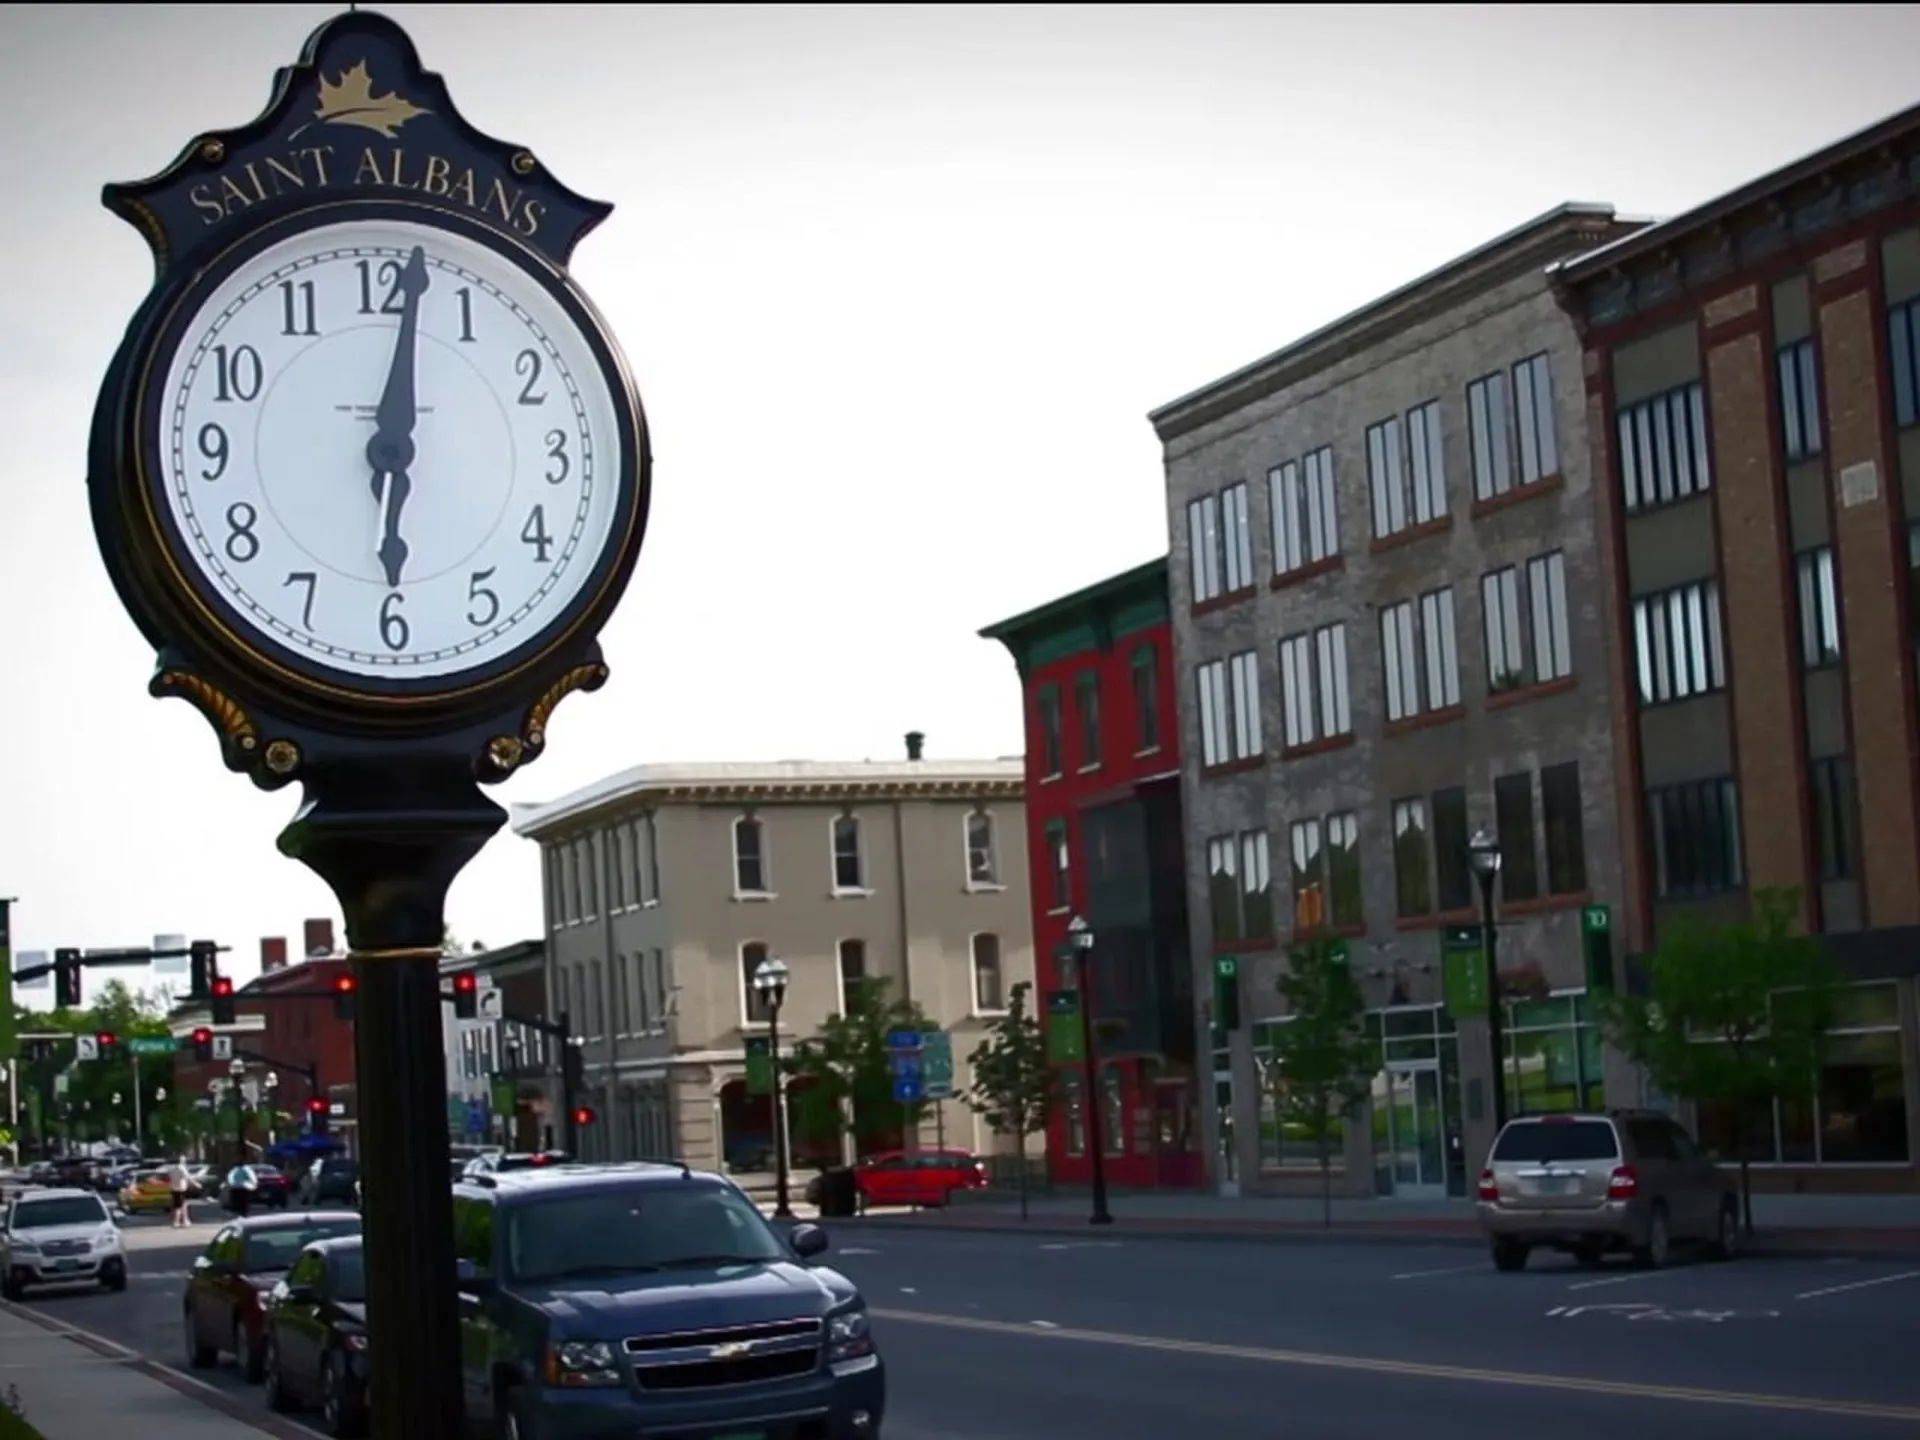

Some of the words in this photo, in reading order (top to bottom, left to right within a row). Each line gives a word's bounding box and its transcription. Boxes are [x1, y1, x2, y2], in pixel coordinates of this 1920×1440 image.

[189, 145, 335, 225] SAINT
[353, 147, 547, 237] ALBANS
[279, 280, 319, 336] 11
[356, 259, 407, 314] 12
[456, 287, 475, 342] 1
[212, 344, 263, 402] 10
[516, 349, 547, 405] 2
[199, 422, 229, 481] 9
[546, 430, 570, 484] 3
[225, 502, 259, 563] 8
[521, 505, 554, 562] 4
[284, 572, 317, 631] 7
[379, 592, 409, 651] 6
[467, 568, 499, 626] 5
